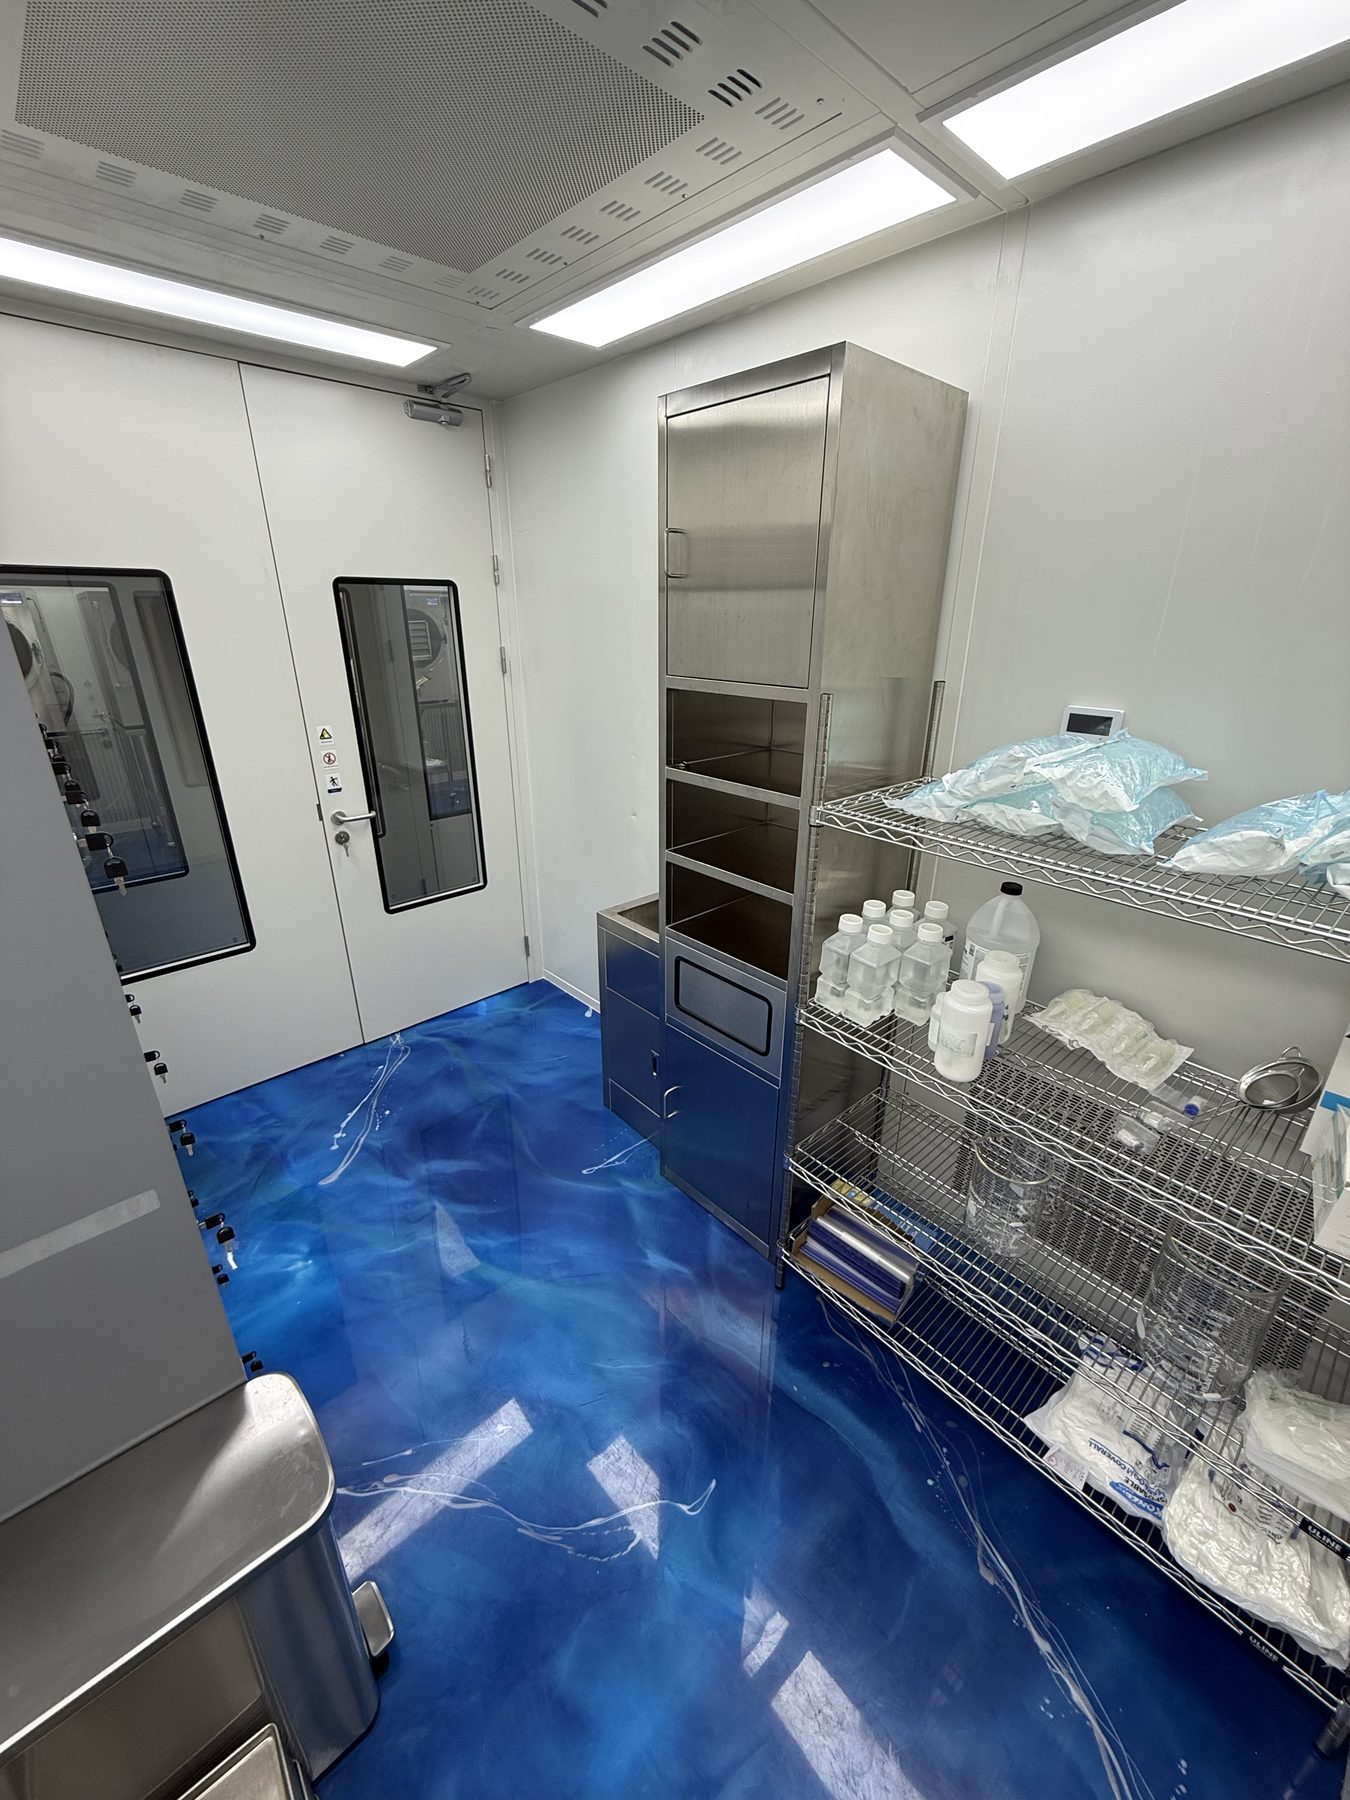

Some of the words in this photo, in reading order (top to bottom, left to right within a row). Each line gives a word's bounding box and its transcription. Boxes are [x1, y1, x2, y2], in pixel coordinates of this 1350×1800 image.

[1088, 1440, 1127, 1470] COVERALL
[1307, 1525, 1343, 1553] ULINE
[1248, 1635, 1279, 1663] ULINE
